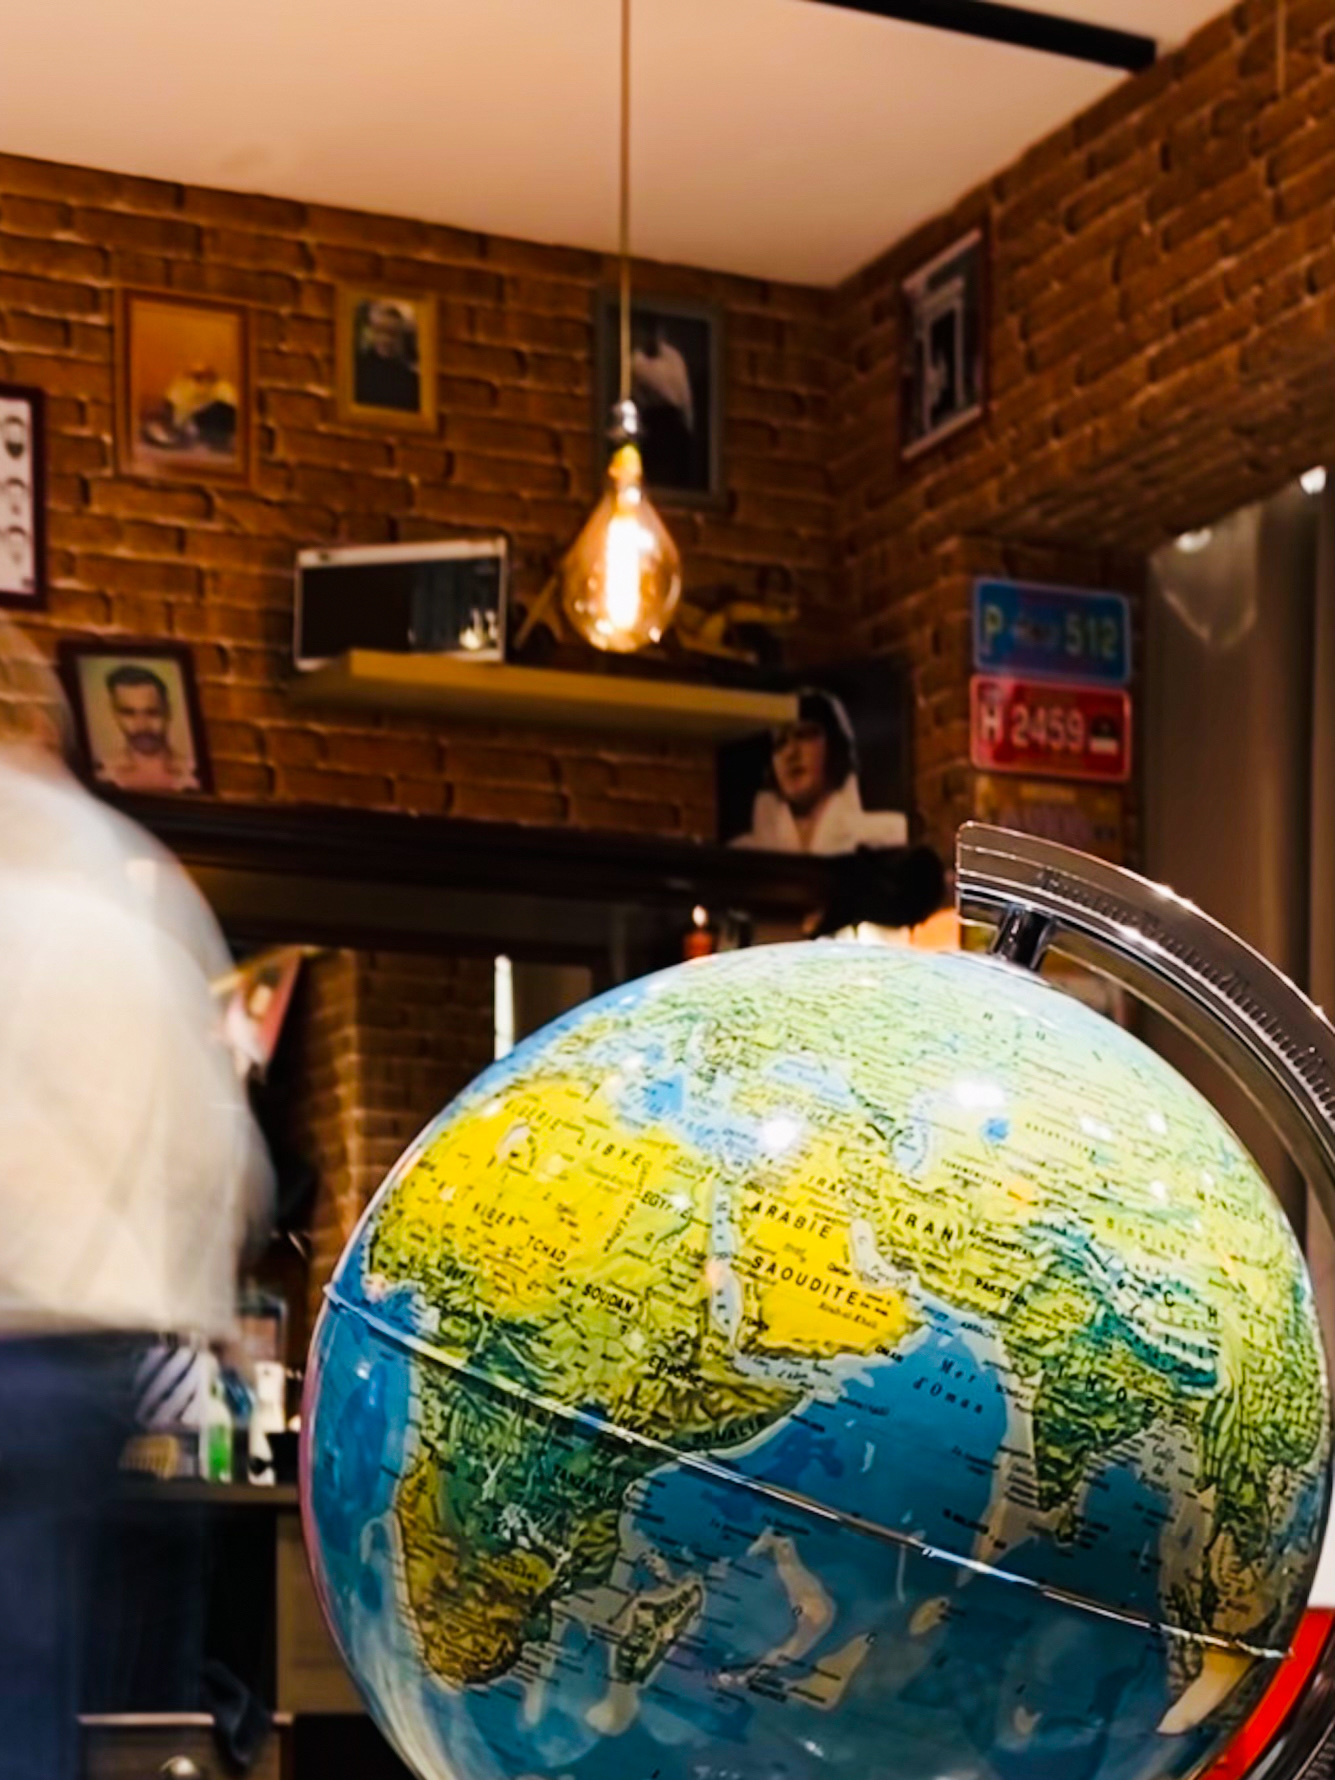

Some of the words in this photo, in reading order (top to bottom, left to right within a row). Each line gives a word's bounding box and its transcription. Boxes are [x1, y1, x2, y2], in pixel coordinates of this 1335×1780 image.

[575, 1132, 644, 1167] LIBYE
[749, 1200, 834, 1240] ARABIE
[893, 1208, 954, 1242] IRAN
[750, 1254, 859, 1306] SAOUDITE
[581, 1283, 634, 1314] SOUDAN
[940, 1358, 976, 1384] Mer
